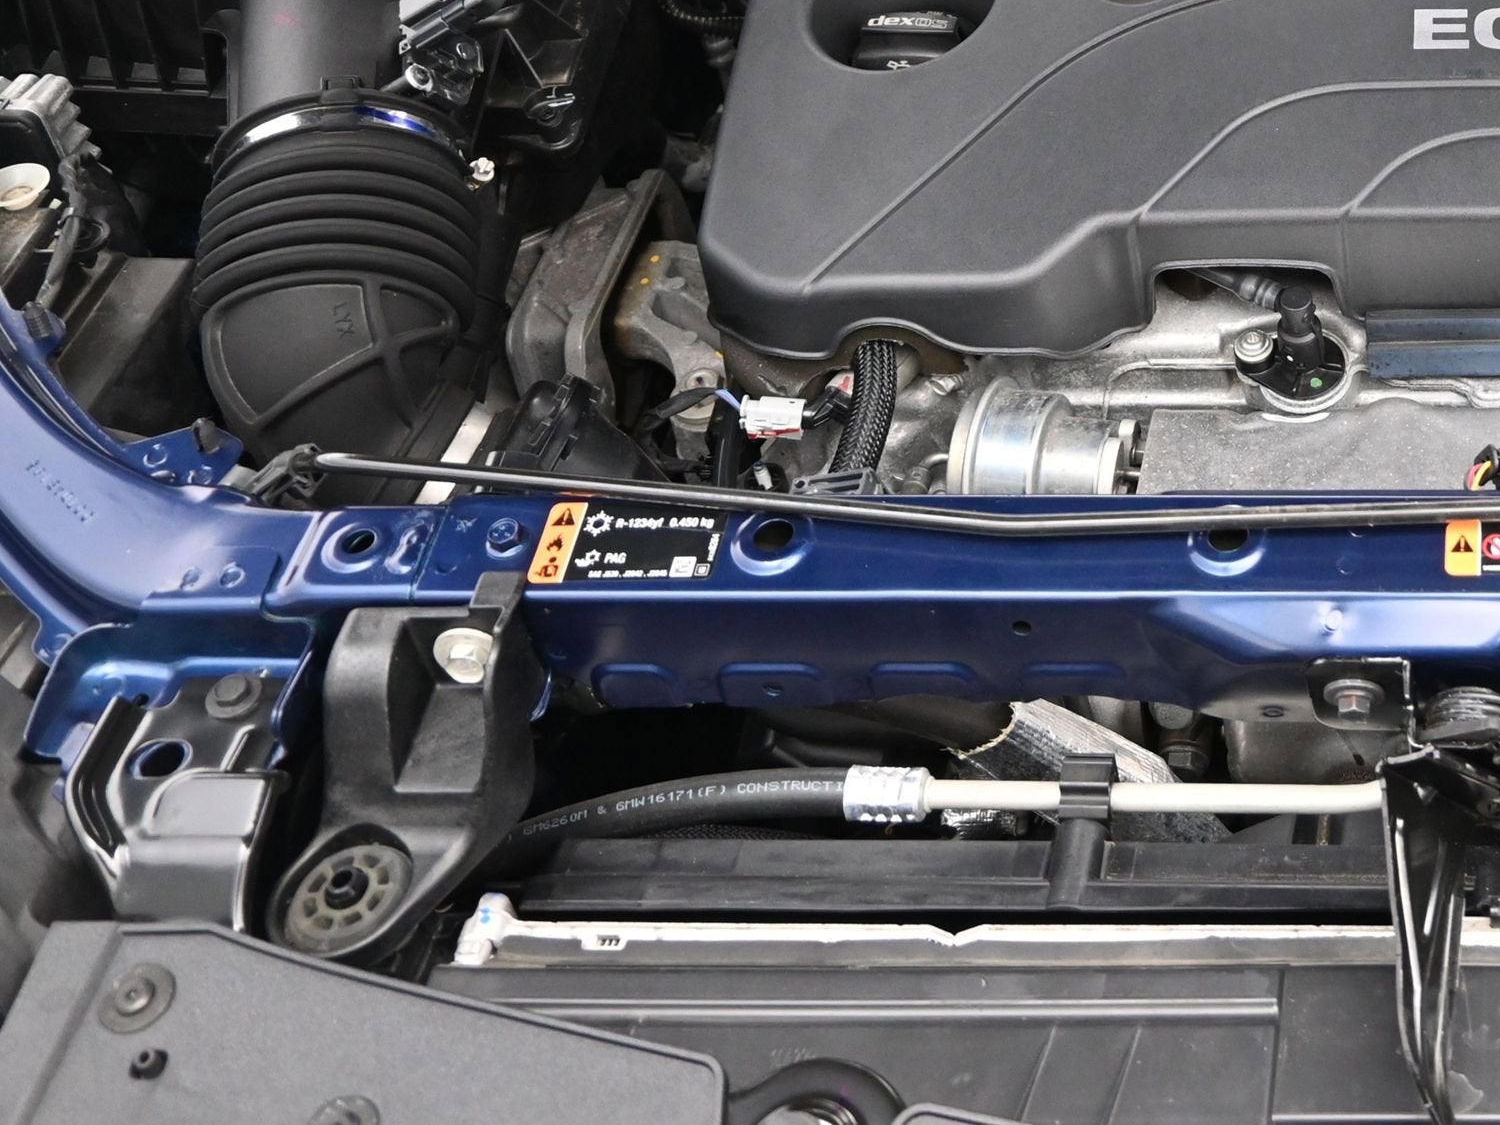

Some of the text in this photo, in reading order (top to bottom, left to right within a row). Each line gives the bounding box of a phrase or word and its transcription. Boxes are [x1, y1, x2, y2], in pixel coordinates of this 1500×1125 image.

[867, 15, 949, 29] dexos
[669, 516, 699, 528] 0.450
[700, 516, 715, 529] kg
[603, 552, 628, 564] PAG
[737, 780, 844, 794] CONSTRUCTI
